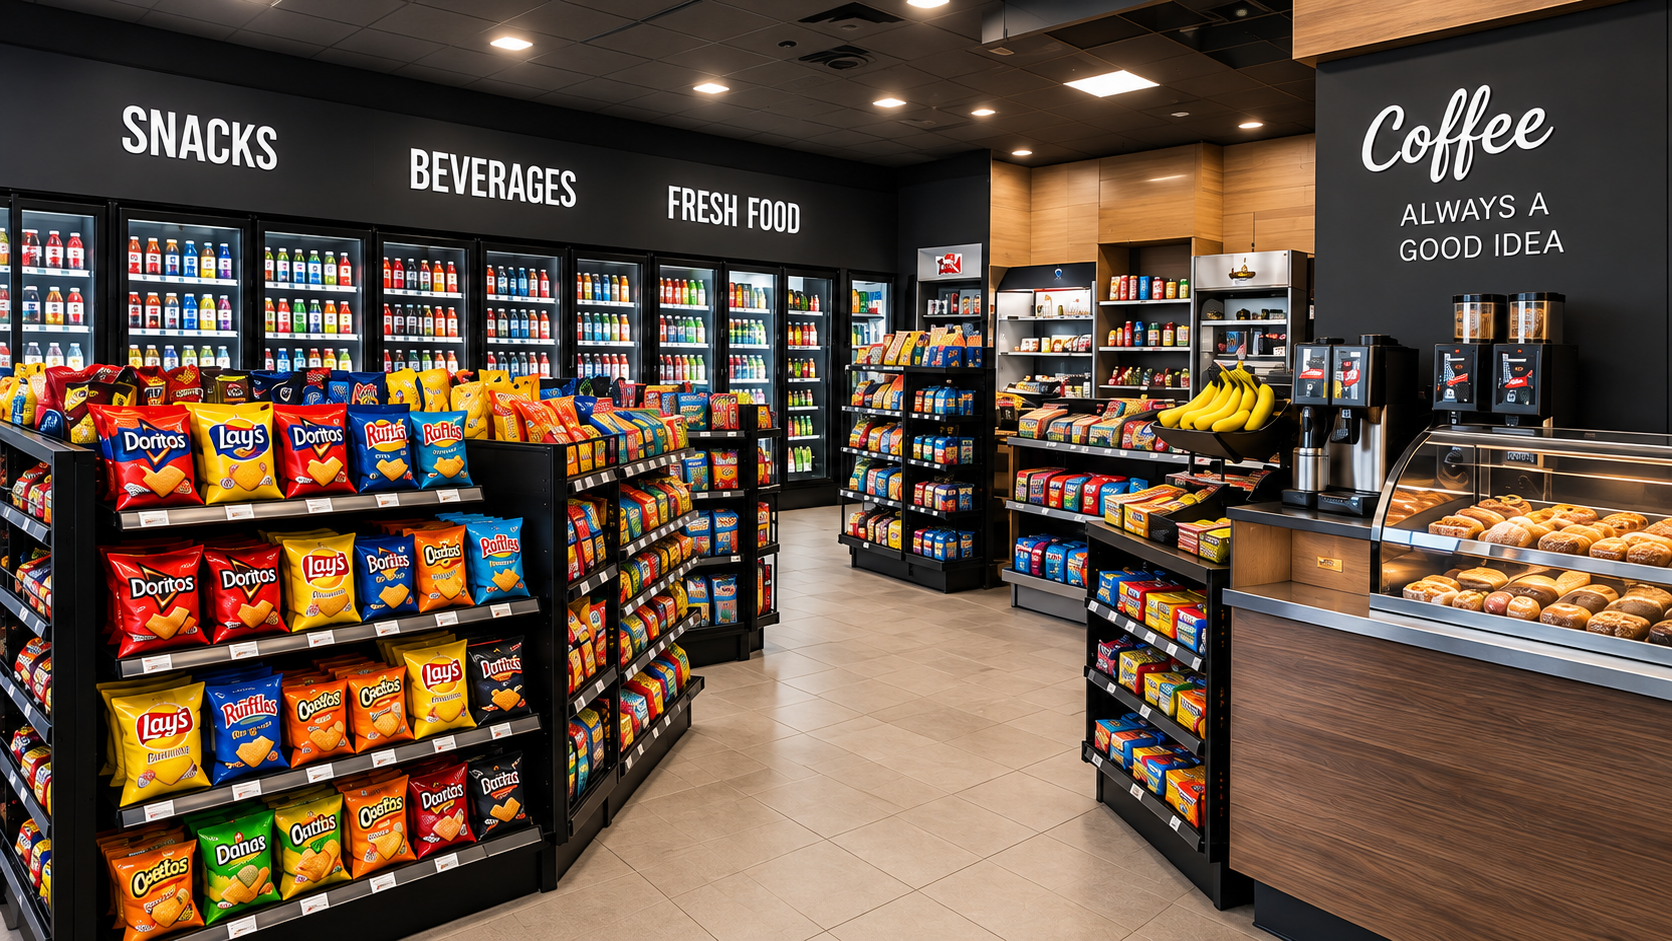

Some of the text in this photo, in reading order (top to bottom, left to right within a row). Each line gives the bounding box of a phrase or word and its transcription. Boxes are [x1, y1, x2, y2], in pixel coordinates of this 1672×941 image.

[122, 105, 278, 171] SNACKS
[1361, 84, 1554, 183] Coffee
[410, 148, 577, 208] BEVERAGES
[668, 185, 800, 234] FRESH FOOD
[1400, 192, 1550, 227] ALWAYS A
[1400, 229, 1565, 262] GOOD IDEA
[125, 431, 186, 451] Doritos
[219, 425, 265, 451] Lay's
[293, 427, 343, 446] Doritos
[222, 569, 277, 589] Doritos
[308, 552, 346, 579] Lay's
[131, 577, 194, 599] Doritos
[426, 661, 460, 686] Lay's
[142, 708, 189, 740] Lay's
